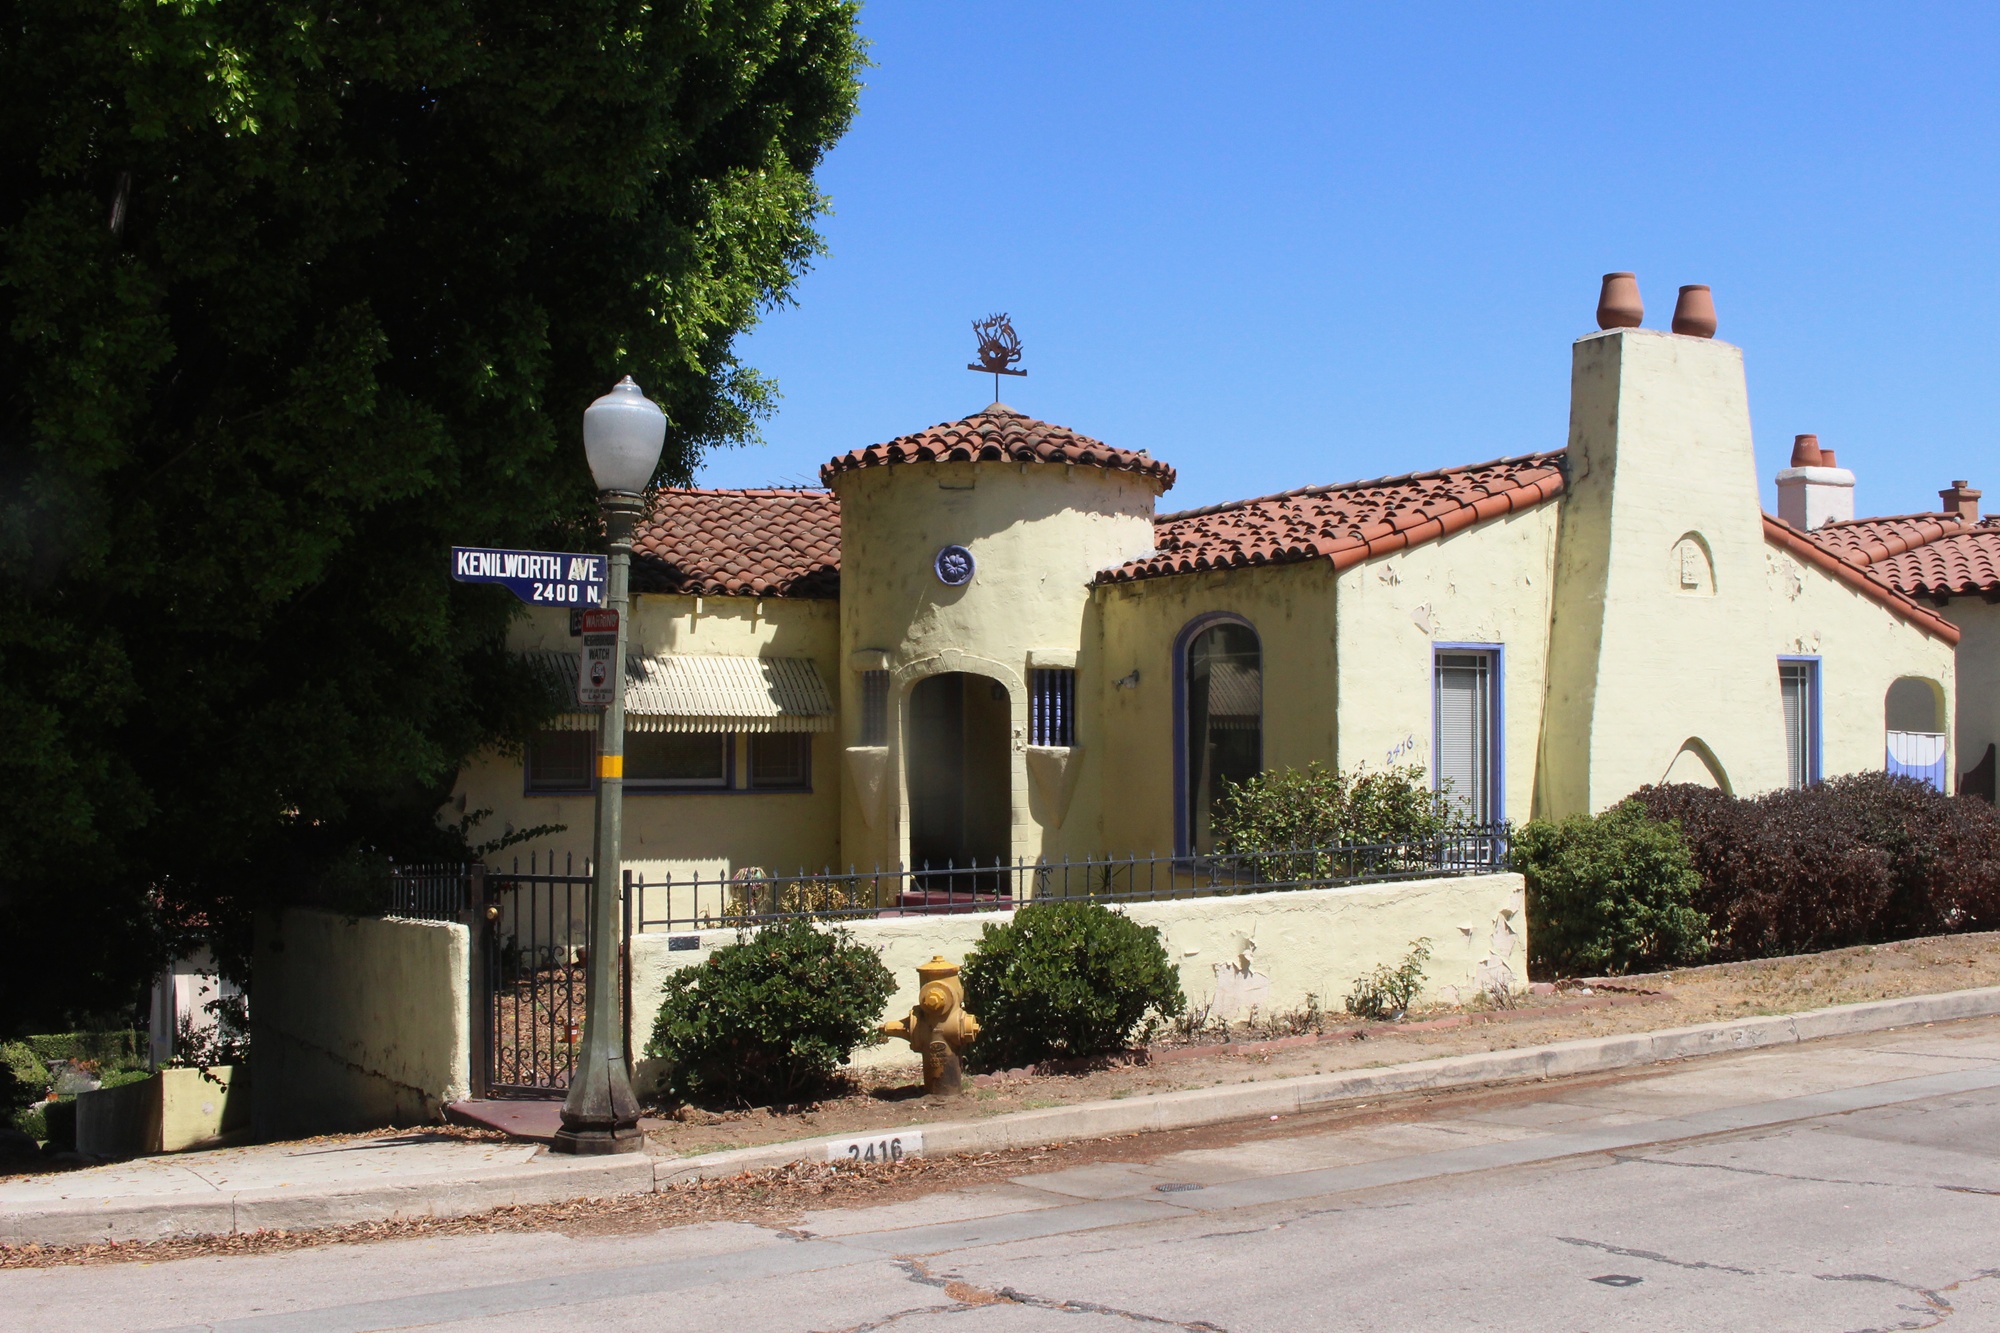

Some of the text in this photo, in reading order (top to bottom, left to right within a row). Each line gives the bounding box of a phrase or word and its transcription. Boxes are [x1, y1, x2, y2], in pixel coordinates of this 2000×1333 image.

[457, 552, 561, 579] KENILWORTH
[533, 582, 578, 602] 2400
[588, 648, 610, 661] WATCH
[1386, 734, 1413, 765] 2416
[848, 1138, 903, 1162] 2416
